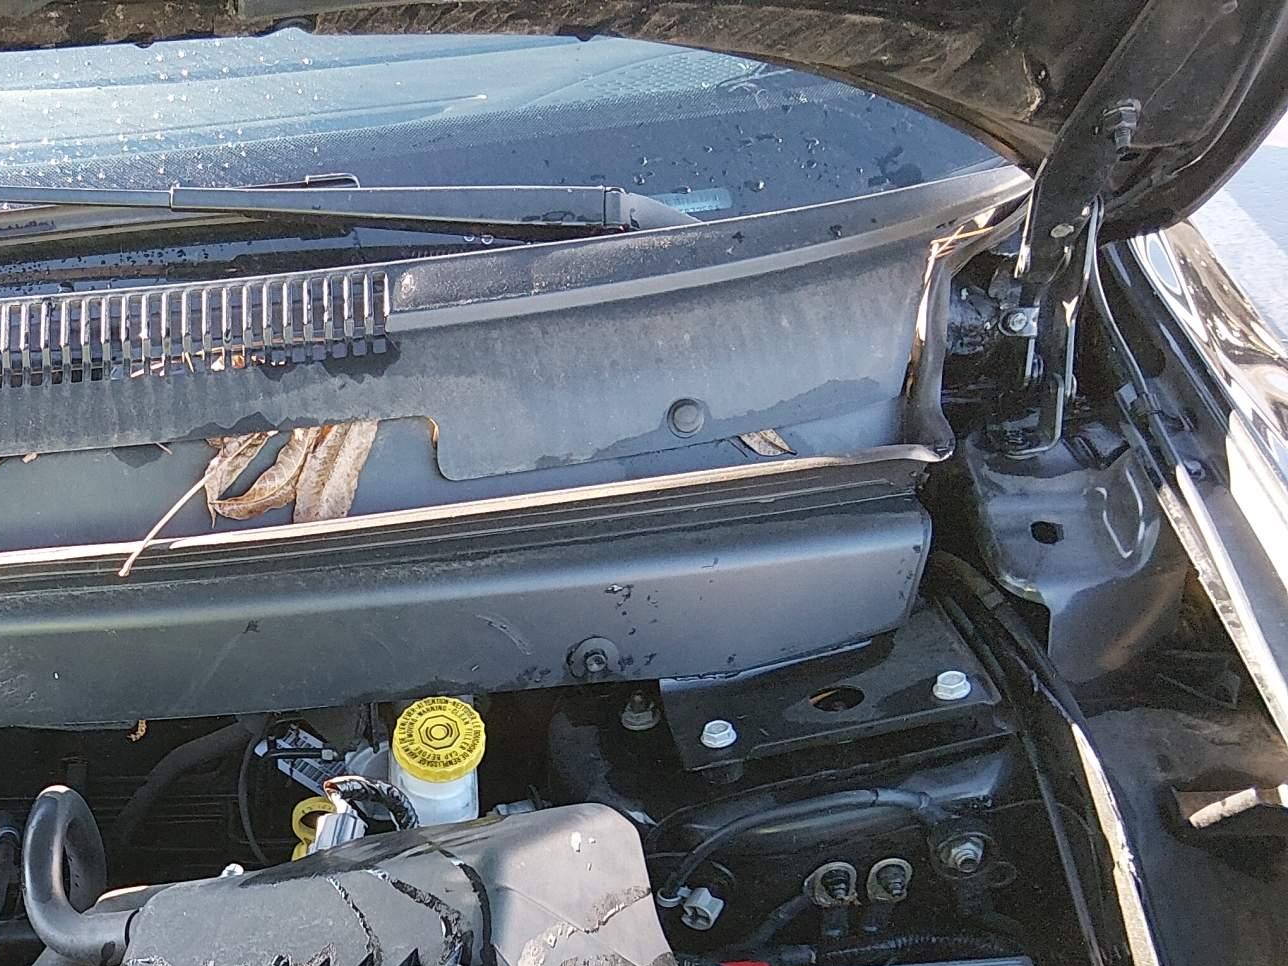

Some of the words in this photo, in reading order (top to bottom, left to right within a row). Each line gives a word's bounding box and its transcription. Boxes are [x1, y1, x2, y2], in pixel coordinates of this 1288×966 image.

[418, 706, 447, 716] WARNING
[451, 709, 470, 725] CLEAN
[407, 719, 417, 745] REMOVING
[460, 728, 472, 750] FILLER
[414, 747, 440, 760] BEFORE
[445, 751, 458, 760] CAP
